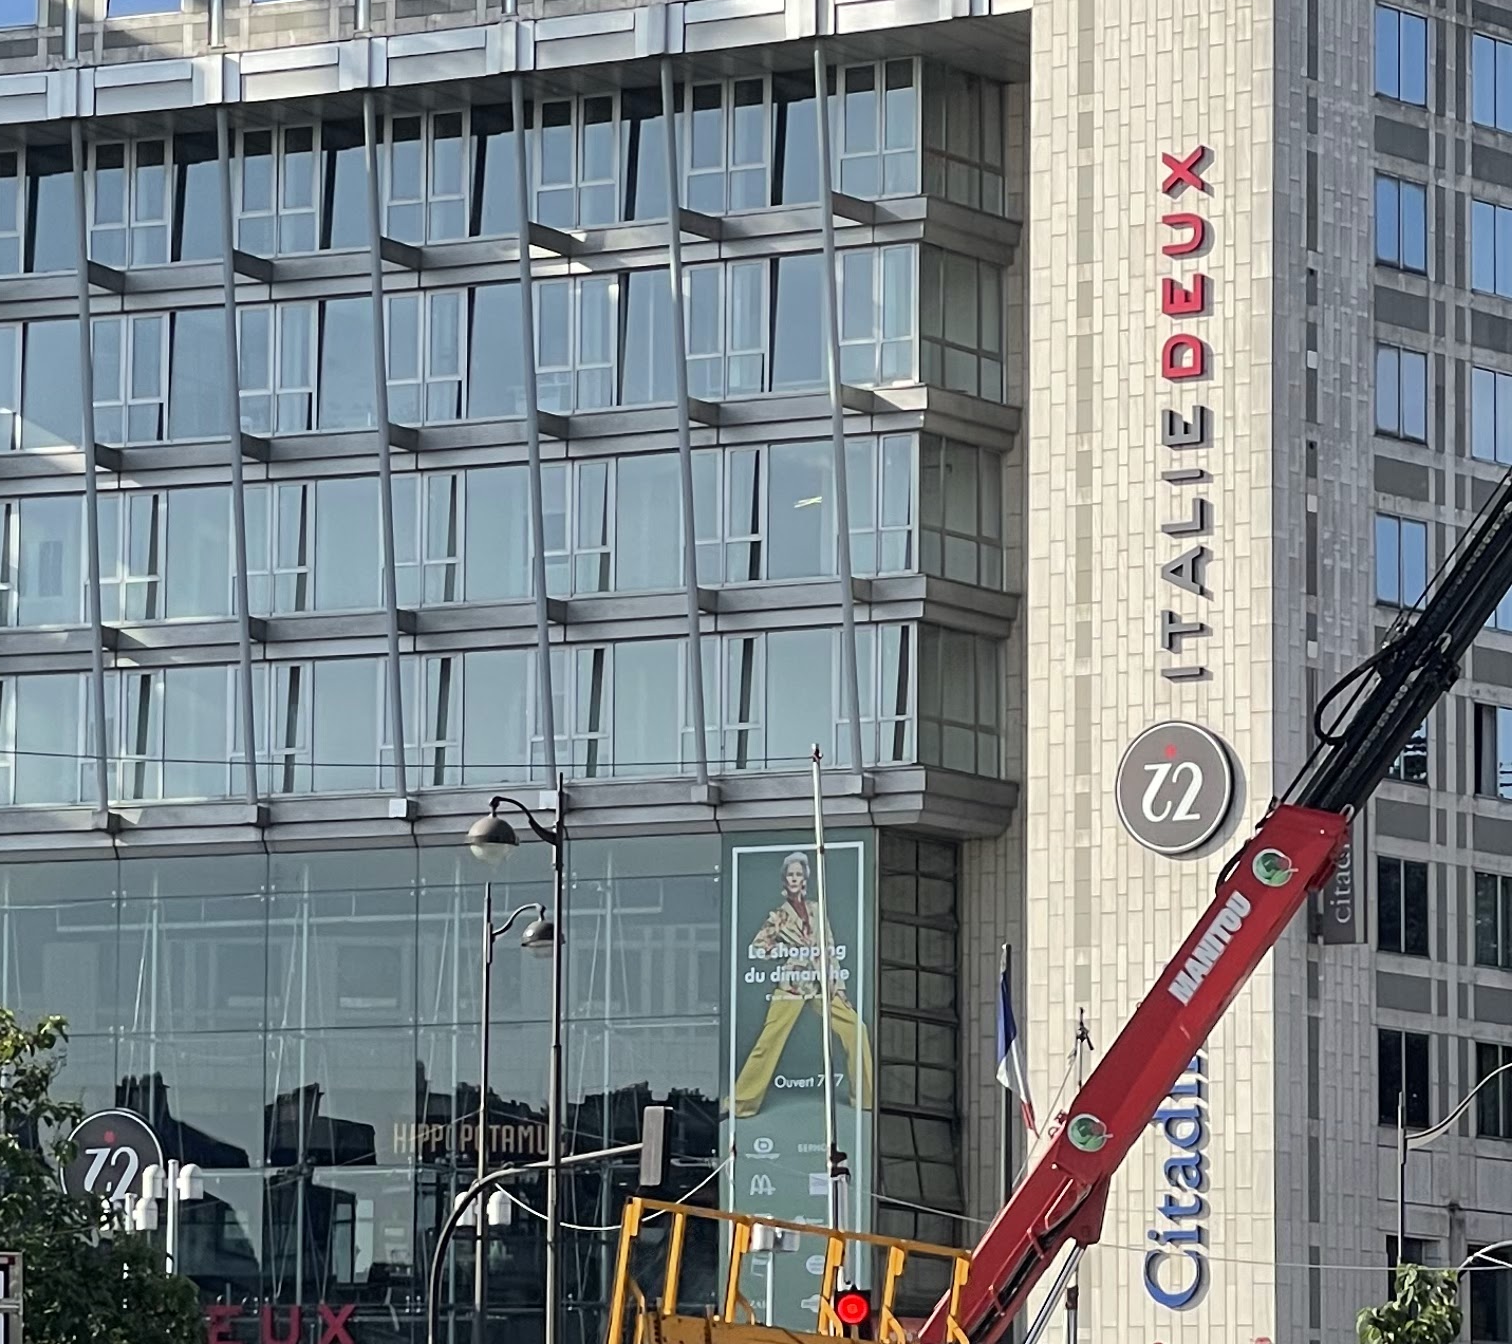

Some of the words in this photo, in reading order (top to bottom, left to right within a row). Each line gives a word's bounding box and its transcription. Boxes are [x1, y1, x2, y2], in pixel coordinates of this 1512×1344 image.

[748, 945, 767, 959] Le
[770, 942, 846, 961] shoppng
[1168, 890, 1251, 1006] MANITOU
[744, 967, 765, 983] du
[770, 966, 850, 983] dimanhe
[774, 1075, 814, 1088] Ouvert
